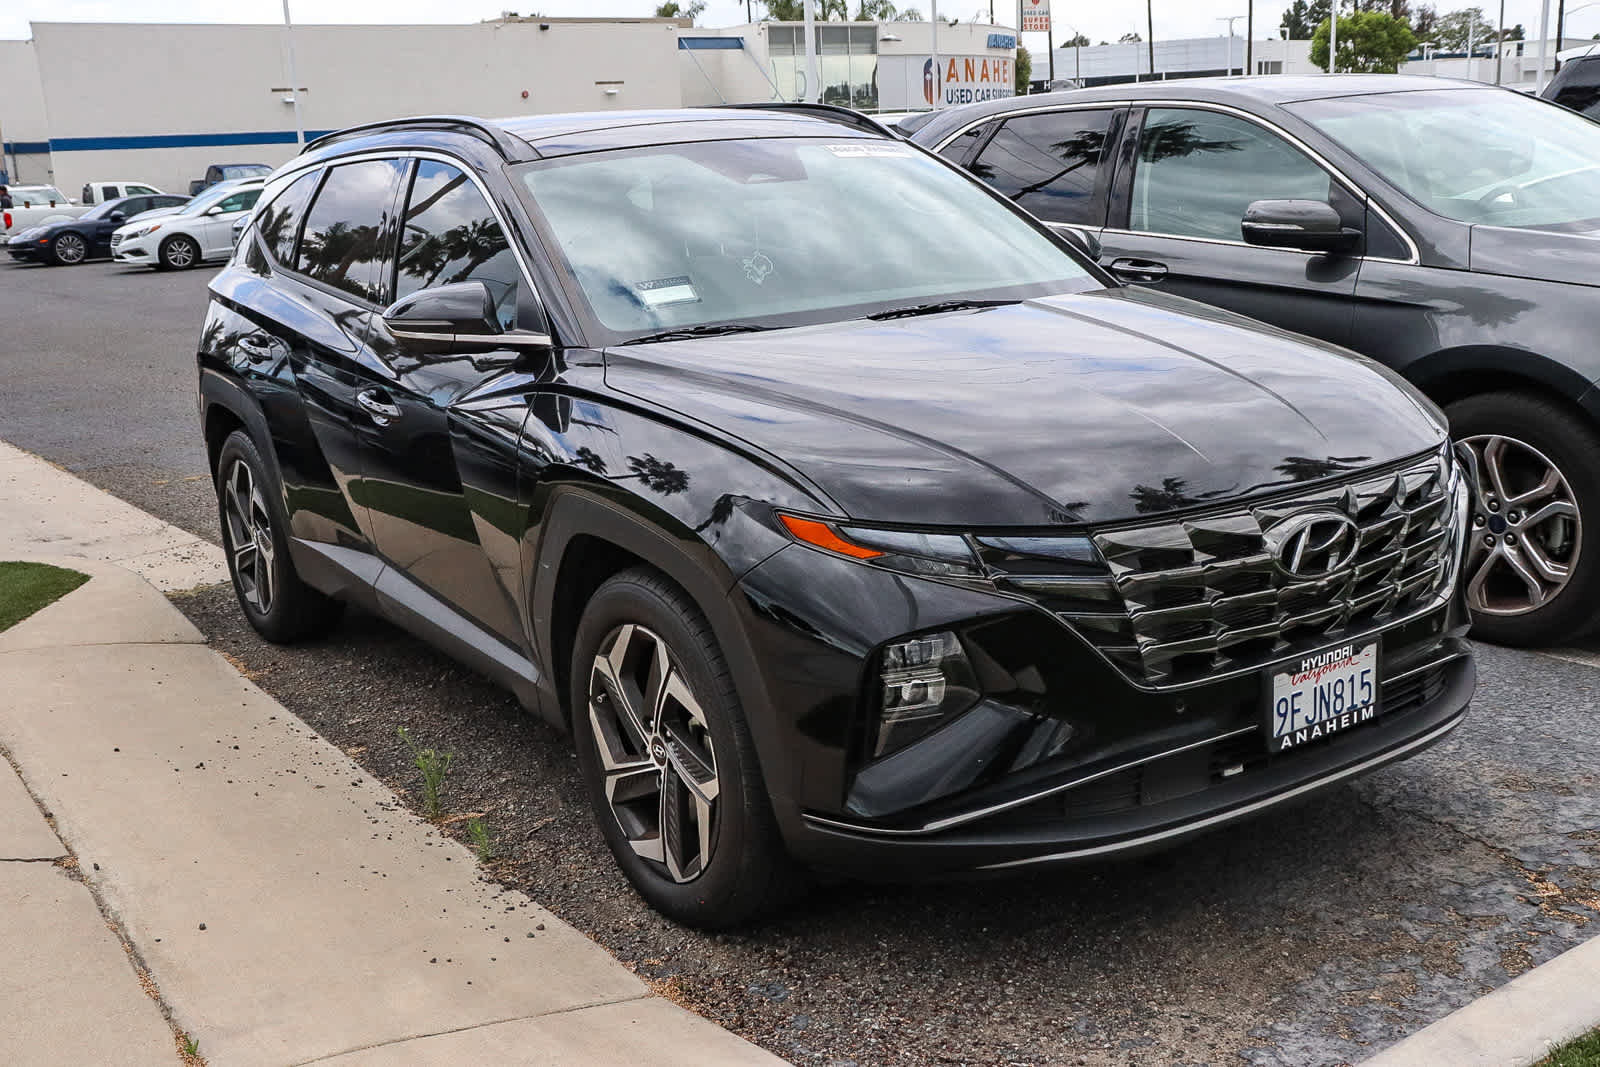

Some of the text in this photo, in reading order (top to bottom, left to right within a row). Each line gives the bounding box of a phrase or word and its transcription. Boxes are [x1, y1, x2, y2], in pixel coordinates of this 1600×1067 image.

[946, 88, 973, 104] USED
[975, 89, 991, 103] CAR
[1291, 656, 1360, 686] California
[1301, 645, 1353, 671] HYUNDAI
[1276, 668, 1372, 737] 9FJN815
[1280, 705, 1374, 749] ANAHEIM
